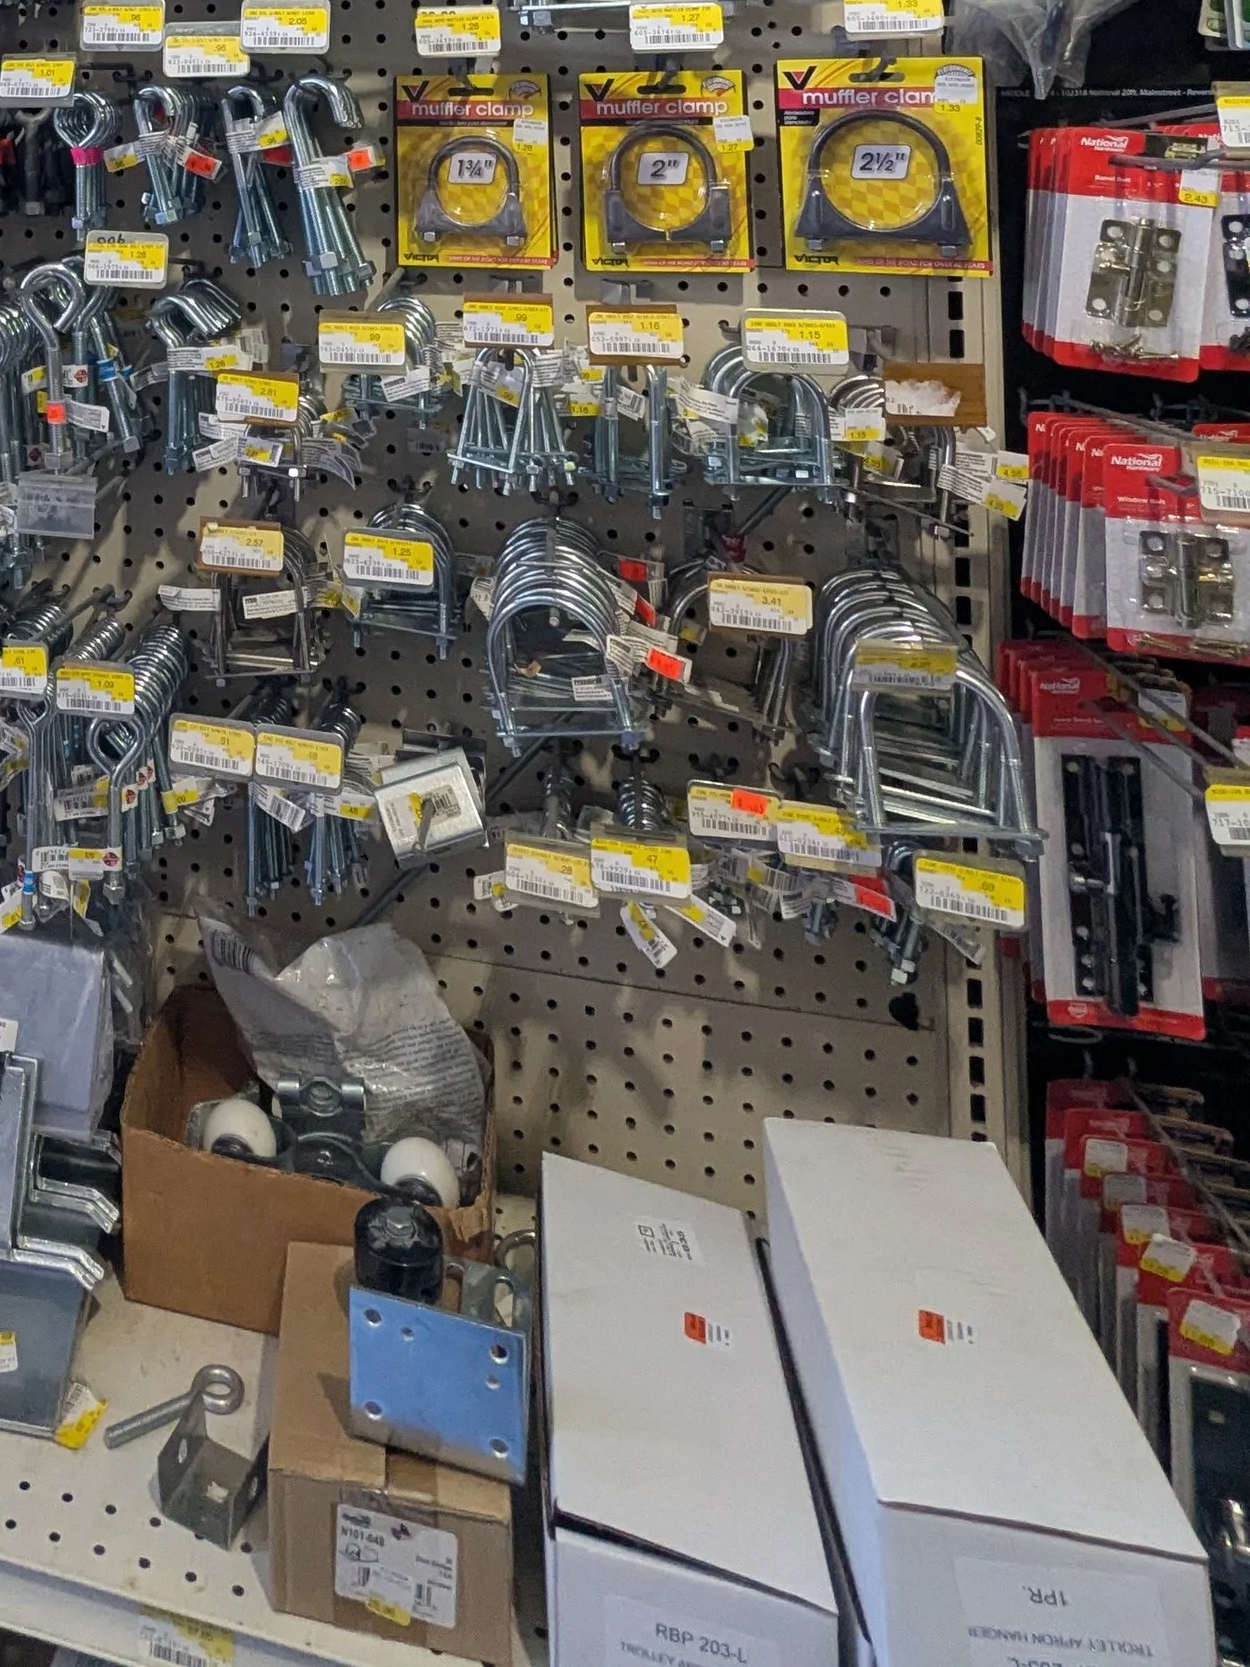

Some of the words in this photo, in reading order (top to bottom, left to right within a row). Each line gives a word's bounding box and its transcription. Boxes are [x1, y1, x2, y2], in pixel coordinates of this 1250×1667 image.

[897, 0, 919, 9] 1.33
[681, 13, 700, 22] 1.27
[461, 22, 480, 31] 1.28
[802, 90, 879, 106] muffler
[883, 89, 936, 105] clam
[412, 101, 476, 119] muffler
[478, 101, 534, 119] clamp
[596, 100, 666, 117] muffler
[669, 100, 728, 117] clamp
[940, 103, 961, 112] 1.33
[515, 143, 533, 152] 1.28
[721, 143, 739, 153] 1.27
[1080, 136, 1128, 150] National
[1183, 192, 1209, 204] 2.43
[404, 253, 440, 263] VICTOR
[591, 257, 629, 267] VICTOR
[794, 253, 840, 265] VICTOR
[639, 321, 661, 330] 1.16
[799, 330, 822, 340] 1.15
[260, 387, 277, 397] 2.81
[571, 405, 589, 415] 1.16
[848, 430, 867, 439] 1.15
[1111, 454, 1163, 468] National
[246, 538, 264, 547] 2.57
[393, 547, 412, 557] 1.25
[761, 596, 782, 607] 3.41
[1021, 1583, 1069, 1608] 1PR.
[968, 1625, 1030, 1643] HANGER
[655, 1622, 694, 1645] RBP
[698, 1636, 748, 1665] 203-L
[1030, 1632, 1084, 1651] APRON
[1087, 1637, 1155, 1659] TROLLEY
